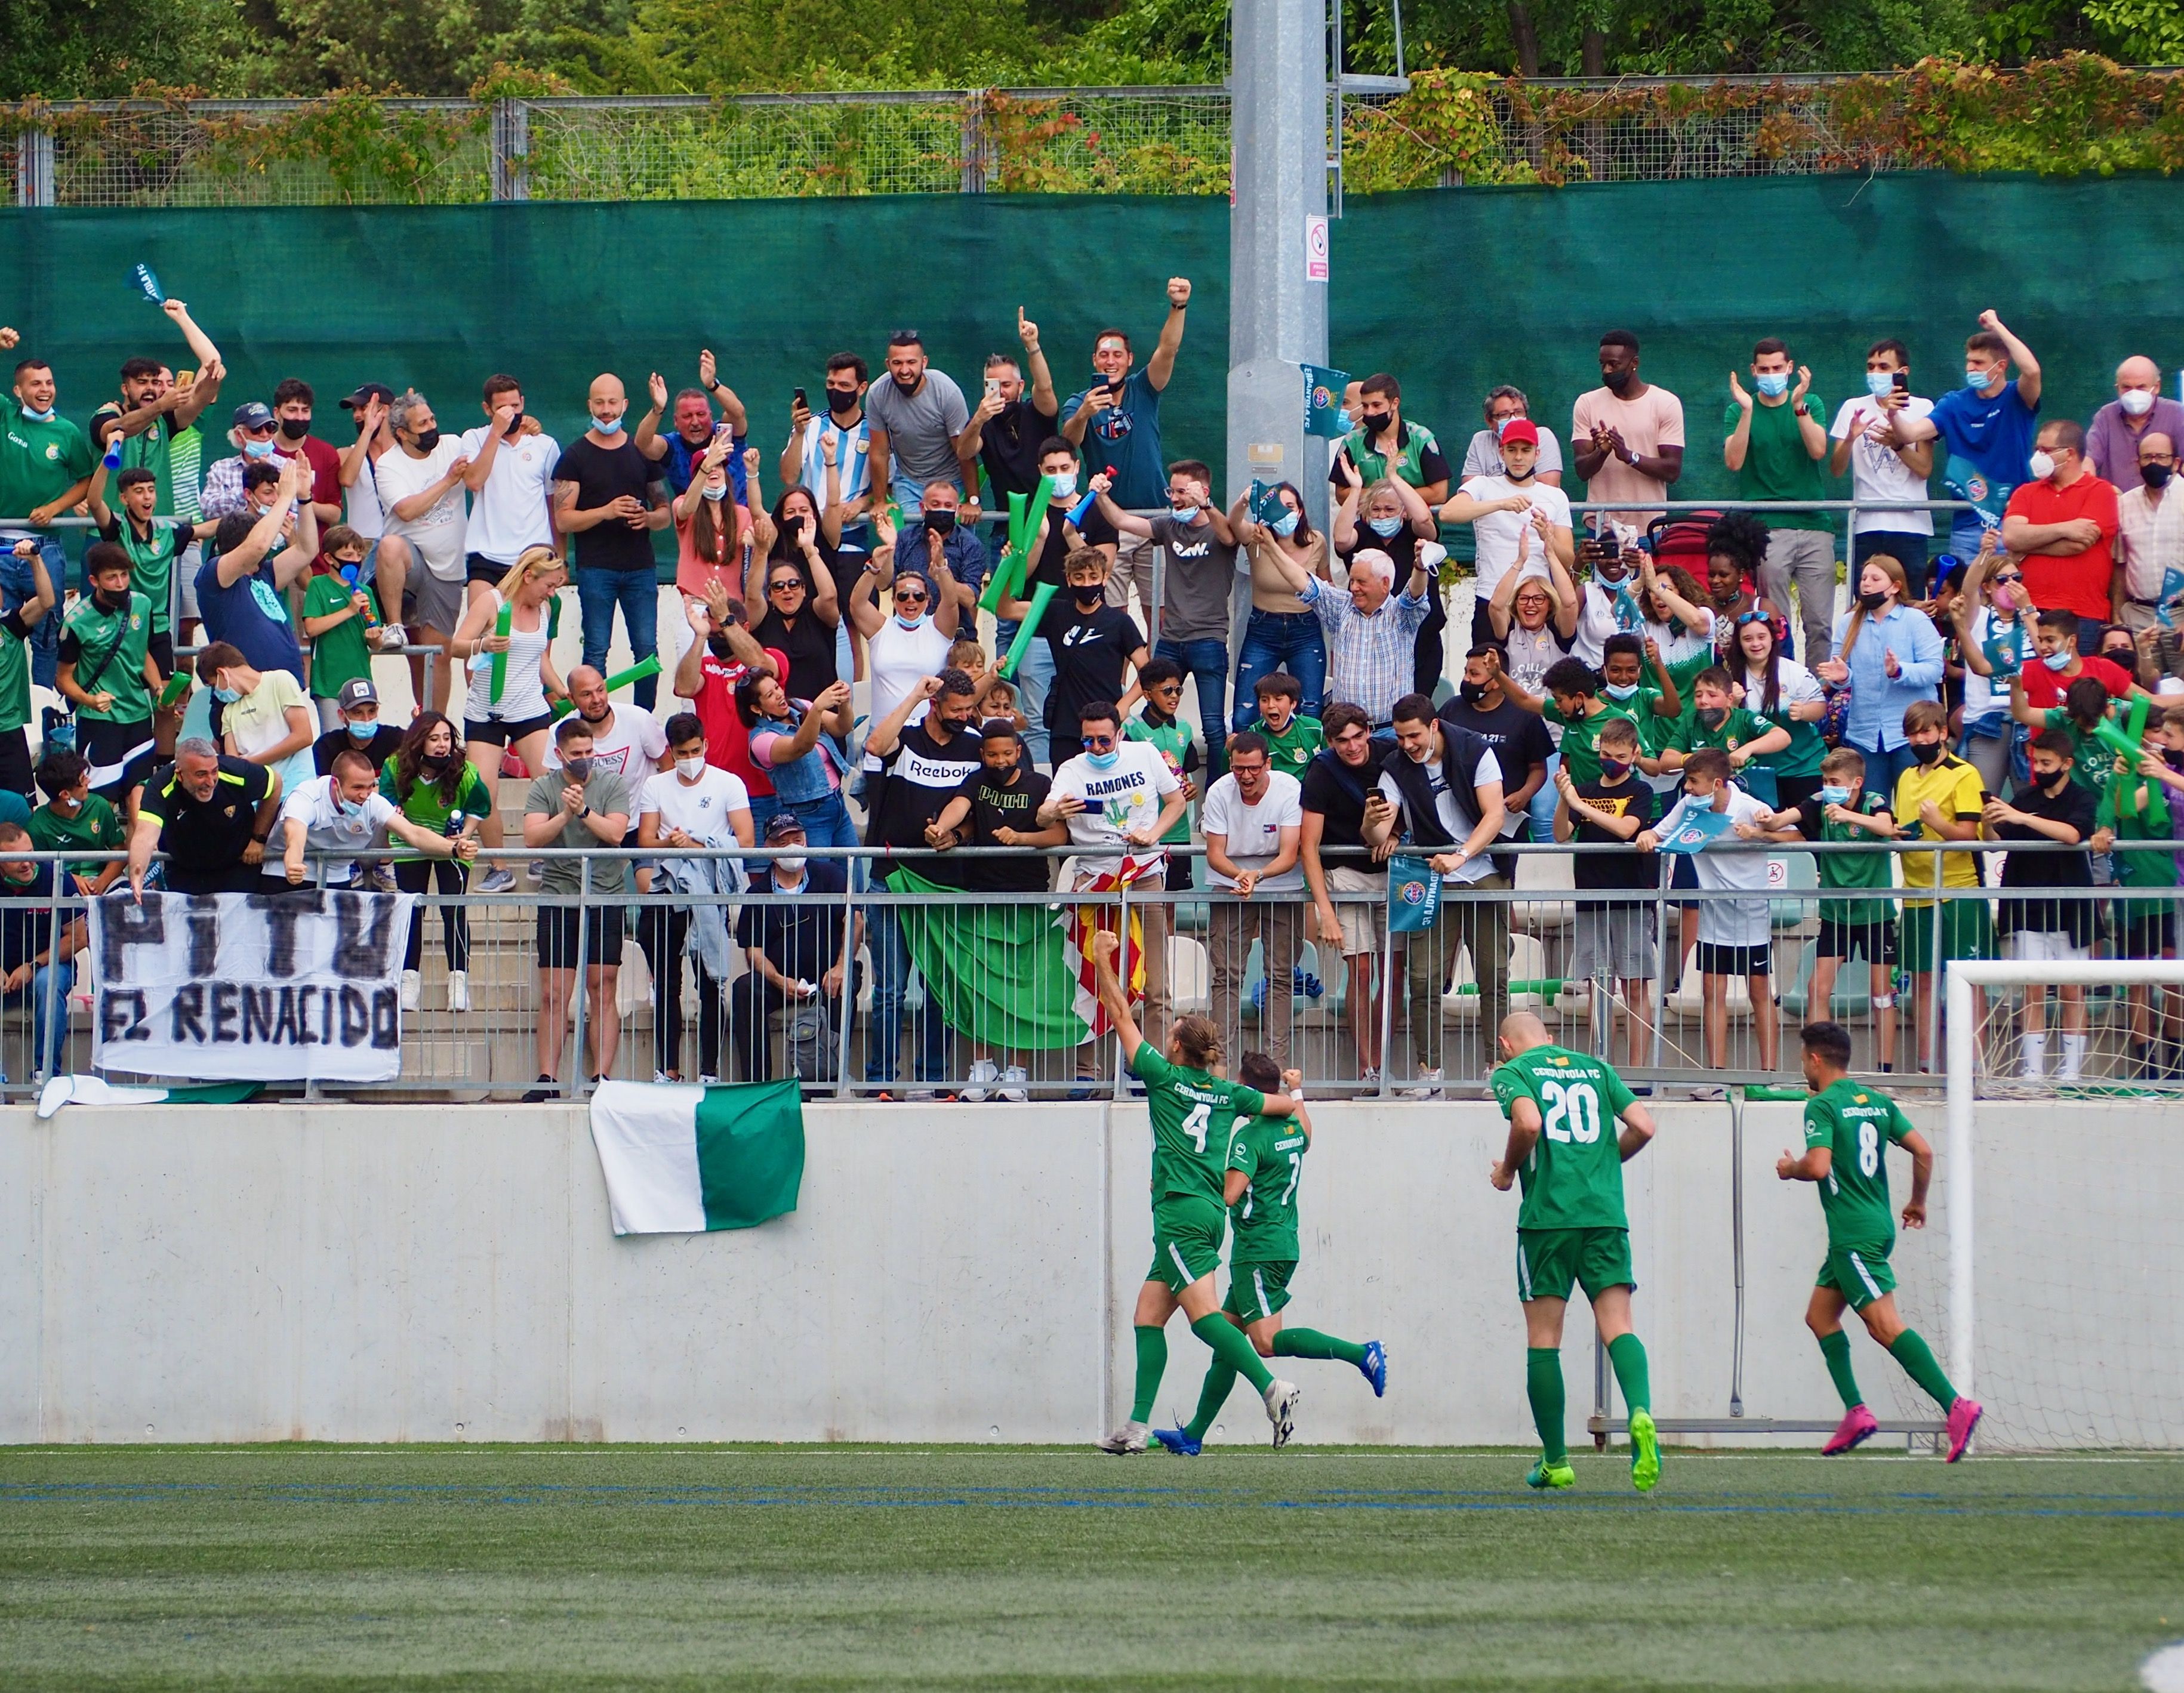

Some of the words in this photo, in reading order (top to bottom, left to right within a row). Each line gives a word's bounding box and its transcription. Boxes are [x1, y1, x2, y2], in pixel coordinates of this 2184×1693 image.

[1488, 733, 1499, 743] 21
[910, 760, 971, 778] Reebok
[1085, 771, 1146, 796] RAMONES
[171, 982, 399, 1049] RENACIDO
[1219, 1096, 1229, 1104] FC
[1541, 1080, 1601, 1144] 20
[1181, 1102, 1212, 1154] 4
[1859, 1121, 1878, 1178] 8
[1280, 1152, 1301, 1205] 7
